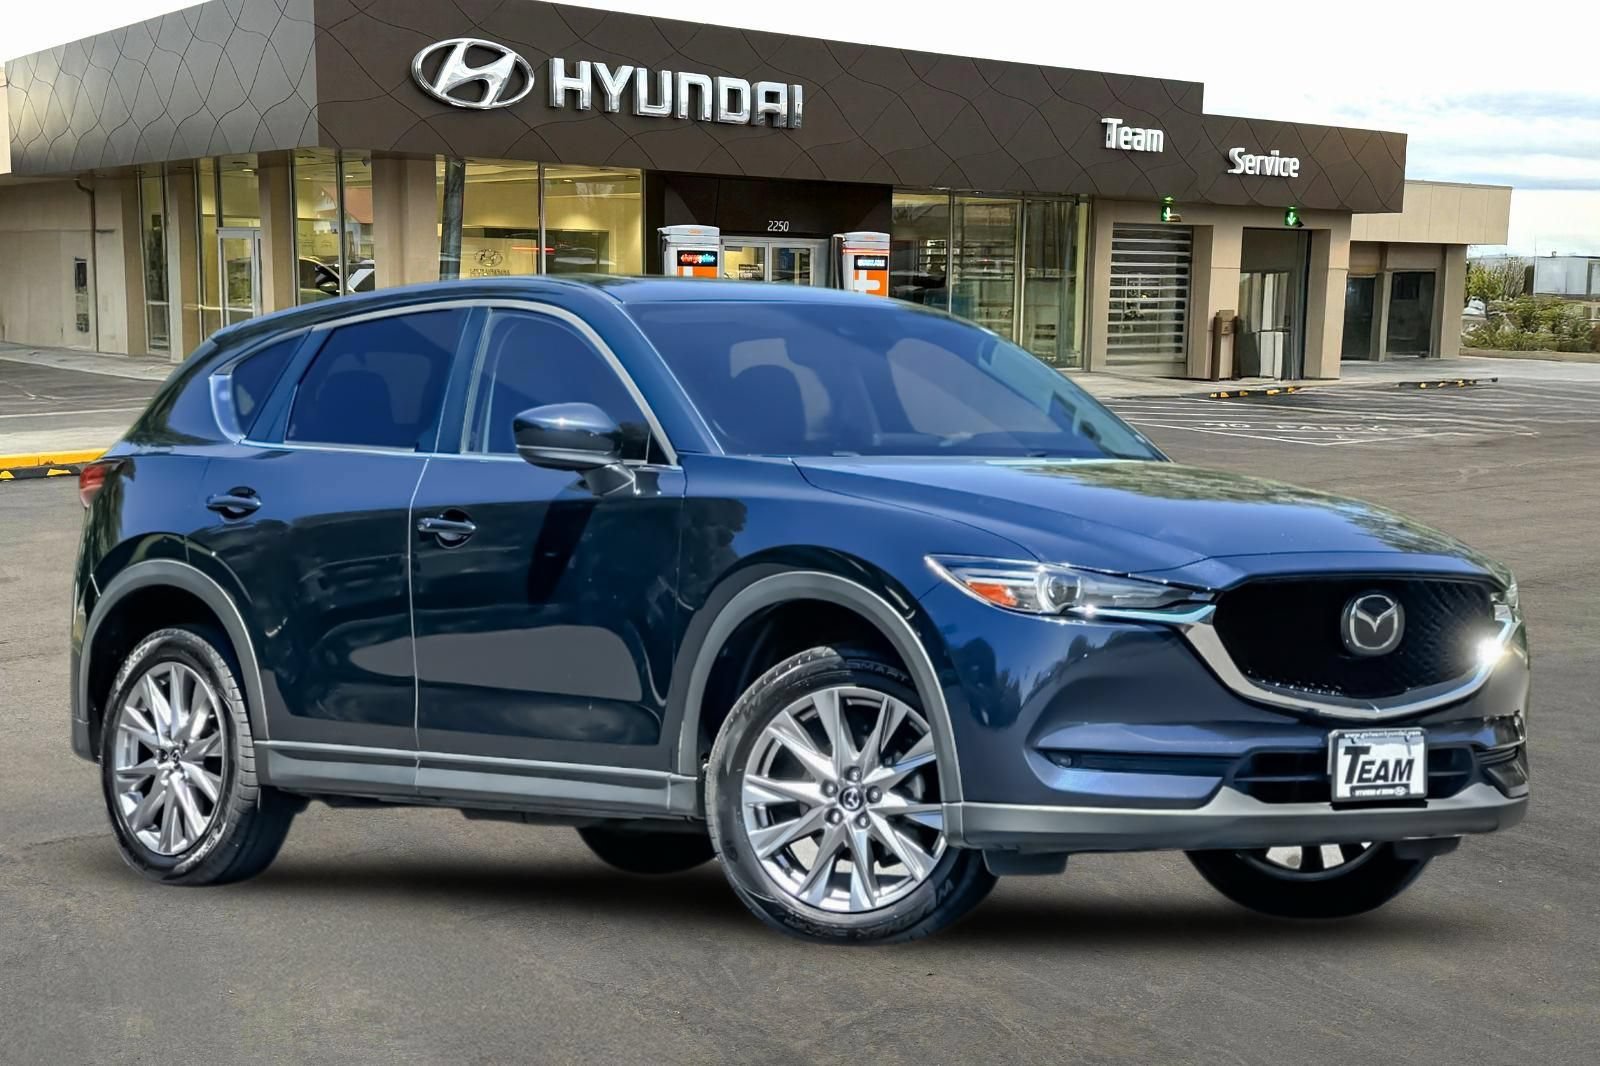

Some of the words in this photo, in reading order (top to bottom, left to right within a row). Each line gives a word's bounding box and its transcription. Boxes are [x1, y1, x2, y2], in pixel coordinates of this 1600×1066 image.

[549, 57, 803, 130] HYUNDAI
[1101, 117, 1164, 153] Team
[1227, 147, 1300, 178] Service
[767, 220, 790, 232] 2250
[1343, 746, 1415, 785] TEAM
